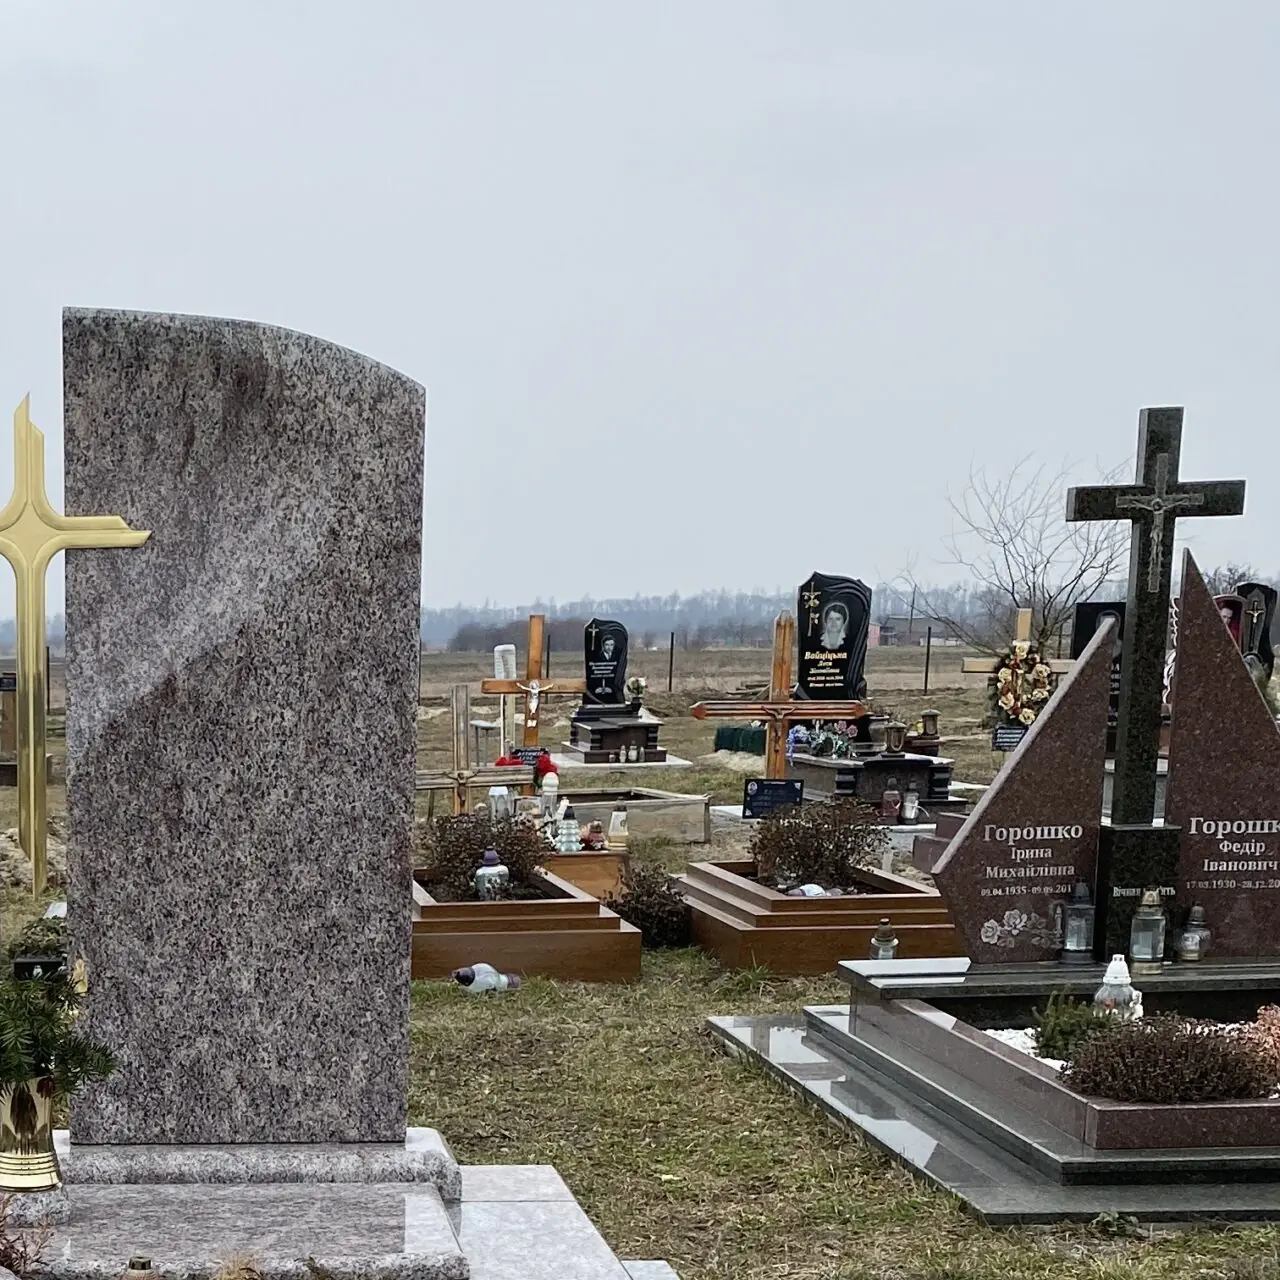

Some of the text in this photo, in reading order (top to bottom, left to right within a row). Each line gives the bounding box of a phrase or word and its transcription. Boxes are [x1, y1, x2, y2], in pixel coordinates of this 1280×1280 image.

[983, 824, 1083, 846] Горошко
[1188, 817, 1280, 839] Горошк
[1011, 847, 1053, 862] Ірина
[1219, 839, 1266, 856] Федір
[985, 864, 1075, 879] Михайлівна
[1203, 859, 1278, 872] Іванович
